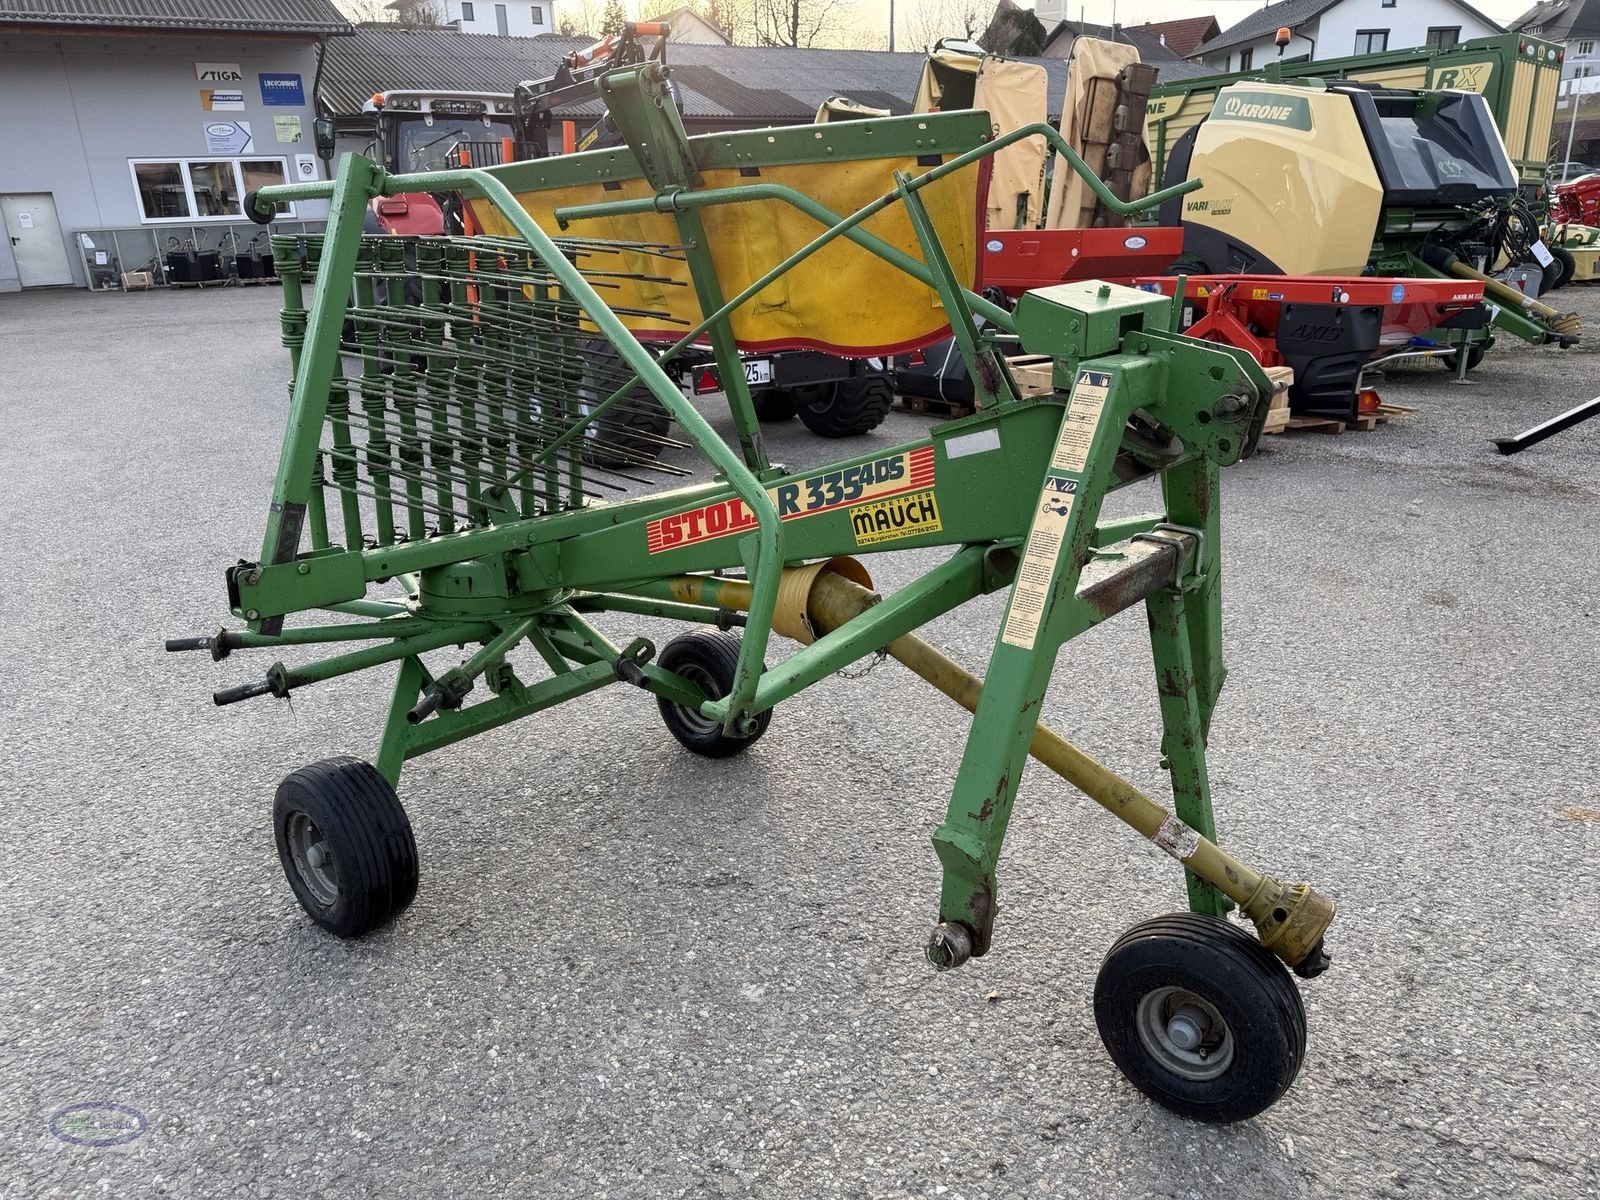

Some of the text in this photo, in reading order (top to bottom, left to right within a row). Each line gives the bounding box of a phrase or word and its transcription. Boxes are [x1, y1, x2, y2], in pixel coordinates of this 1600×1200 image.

[201, 71, 242, 80] STIGA
[1436, 66, 1483, 89] RX
[1238, 103, 1293, 120] KRONE
[1289, 323, 1344, 340] AXIS
[746, 364, 769, 382] 25 km
[851, 492, 932, 515] FACHBETRIEB
[661, 499, 758, 546] STOL
[778, 484, 800, 516] R
[853, 498, 937, 536] MAUCH
